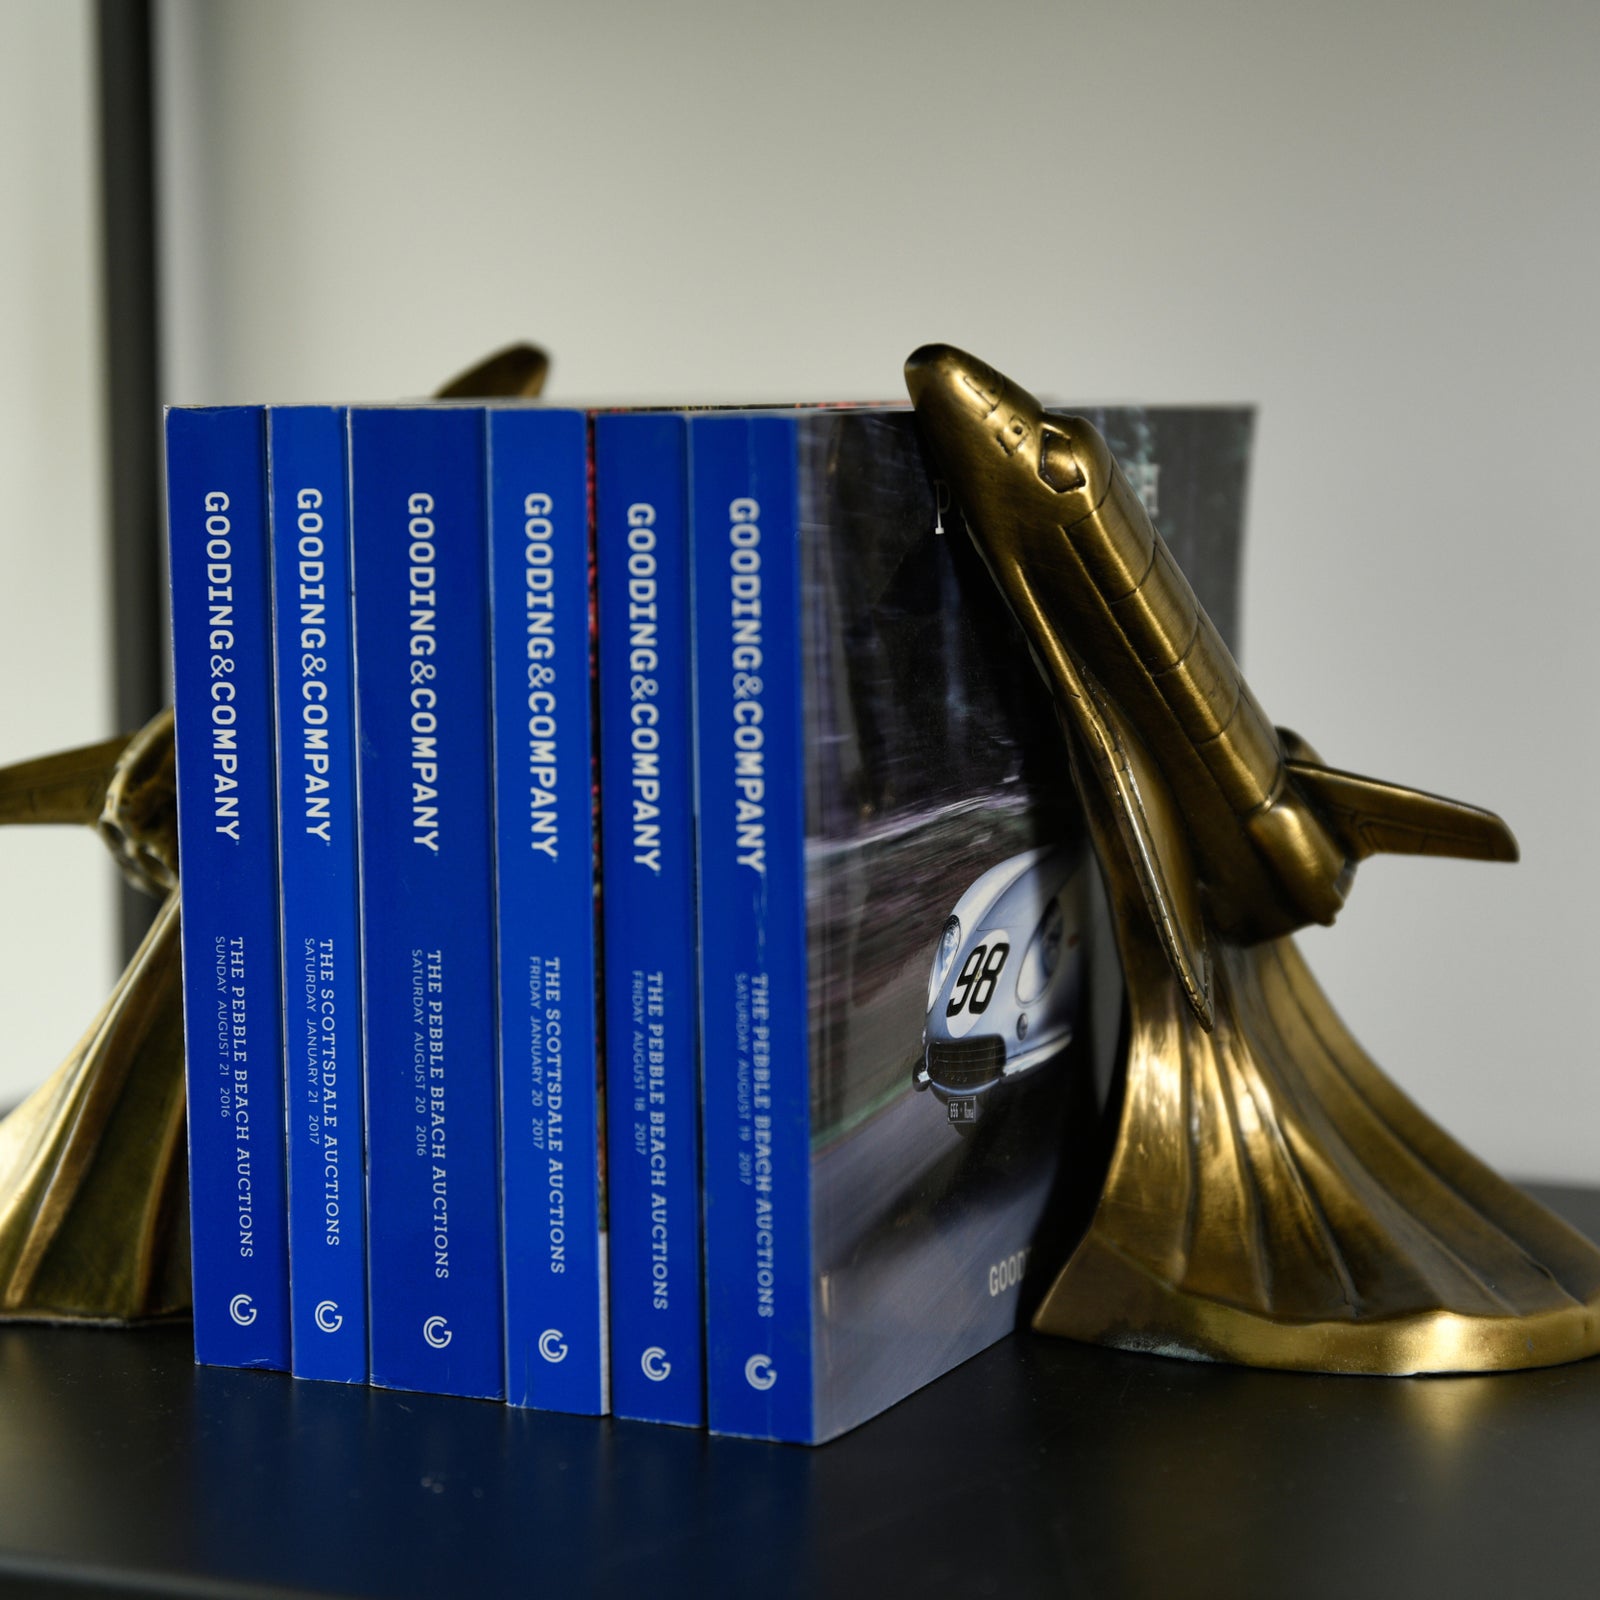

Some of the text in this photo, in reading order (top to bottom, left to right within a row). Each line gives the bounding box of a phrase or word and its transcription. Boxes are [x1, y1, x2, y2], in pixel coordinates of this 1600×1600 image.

[205, 489, 239, 839] GOODING&COMPANY
[297, 489, 330, 841] GOODING&COMPANY
[408, 493, 438, 851] GOODING&COMPANY
[525, 493, 557, 861] GOODING&COMPANY
[628, 501, 660, 871] GOODING&COMPANY
[730, 498, 765, 877] GOODING&COMPANY
[216, 937, 230, 1117] SUNDAY AUGUST 21 2016
[231, 937, 253, 1257] THE PEBBLE BEACH AUCTIONS
[305, 938, 319, 1144] SATURDAY JANUARY 21 2017
[320, 939, 339, 1245] THE SCOTTSDALE AUCTIONS
[412, 950, 426, 1156] SATURDAY AUGUST 20 2016
[428, 950, 448, 1278] THE PEBBLE BEACH AUCTIONS
[530, 957, 544, 1149] FRIDAY JANUARY 20 2017
[545, 957, 564, 1273] THE SCOTTSDALE AUCTIONS
[632, 971, 646, 1155] FRIDAY AUGUST 18 2017
[648, 972, 667, 1309] THE PEBBLE BEACH AUCTIONS
[946, 942, 1010, 1018] 98
[752, 974, 773, 1317] THE PEBBLE BEACH AUCTIONS
